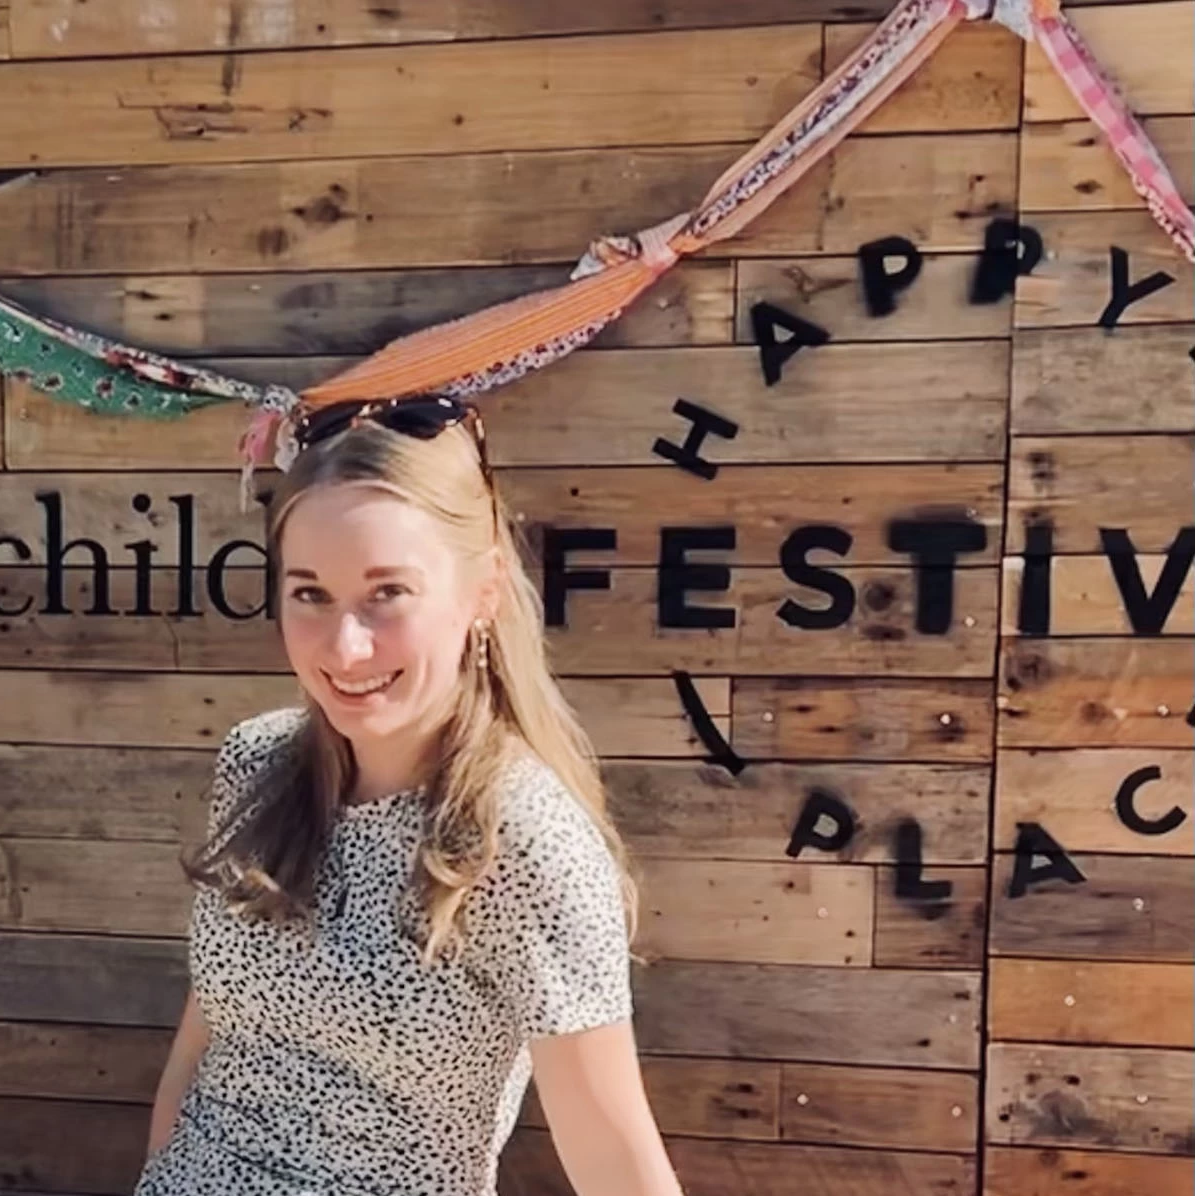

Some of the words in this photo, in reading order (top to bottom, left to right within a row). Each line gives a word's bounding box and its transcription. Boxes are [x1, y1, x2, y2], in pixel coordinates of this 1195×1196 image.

[651, 219, 1175, 480] HAPPY
[543, 519, 1195, 636] FESTIV
[785, 704, 1195, 900] PLAC
